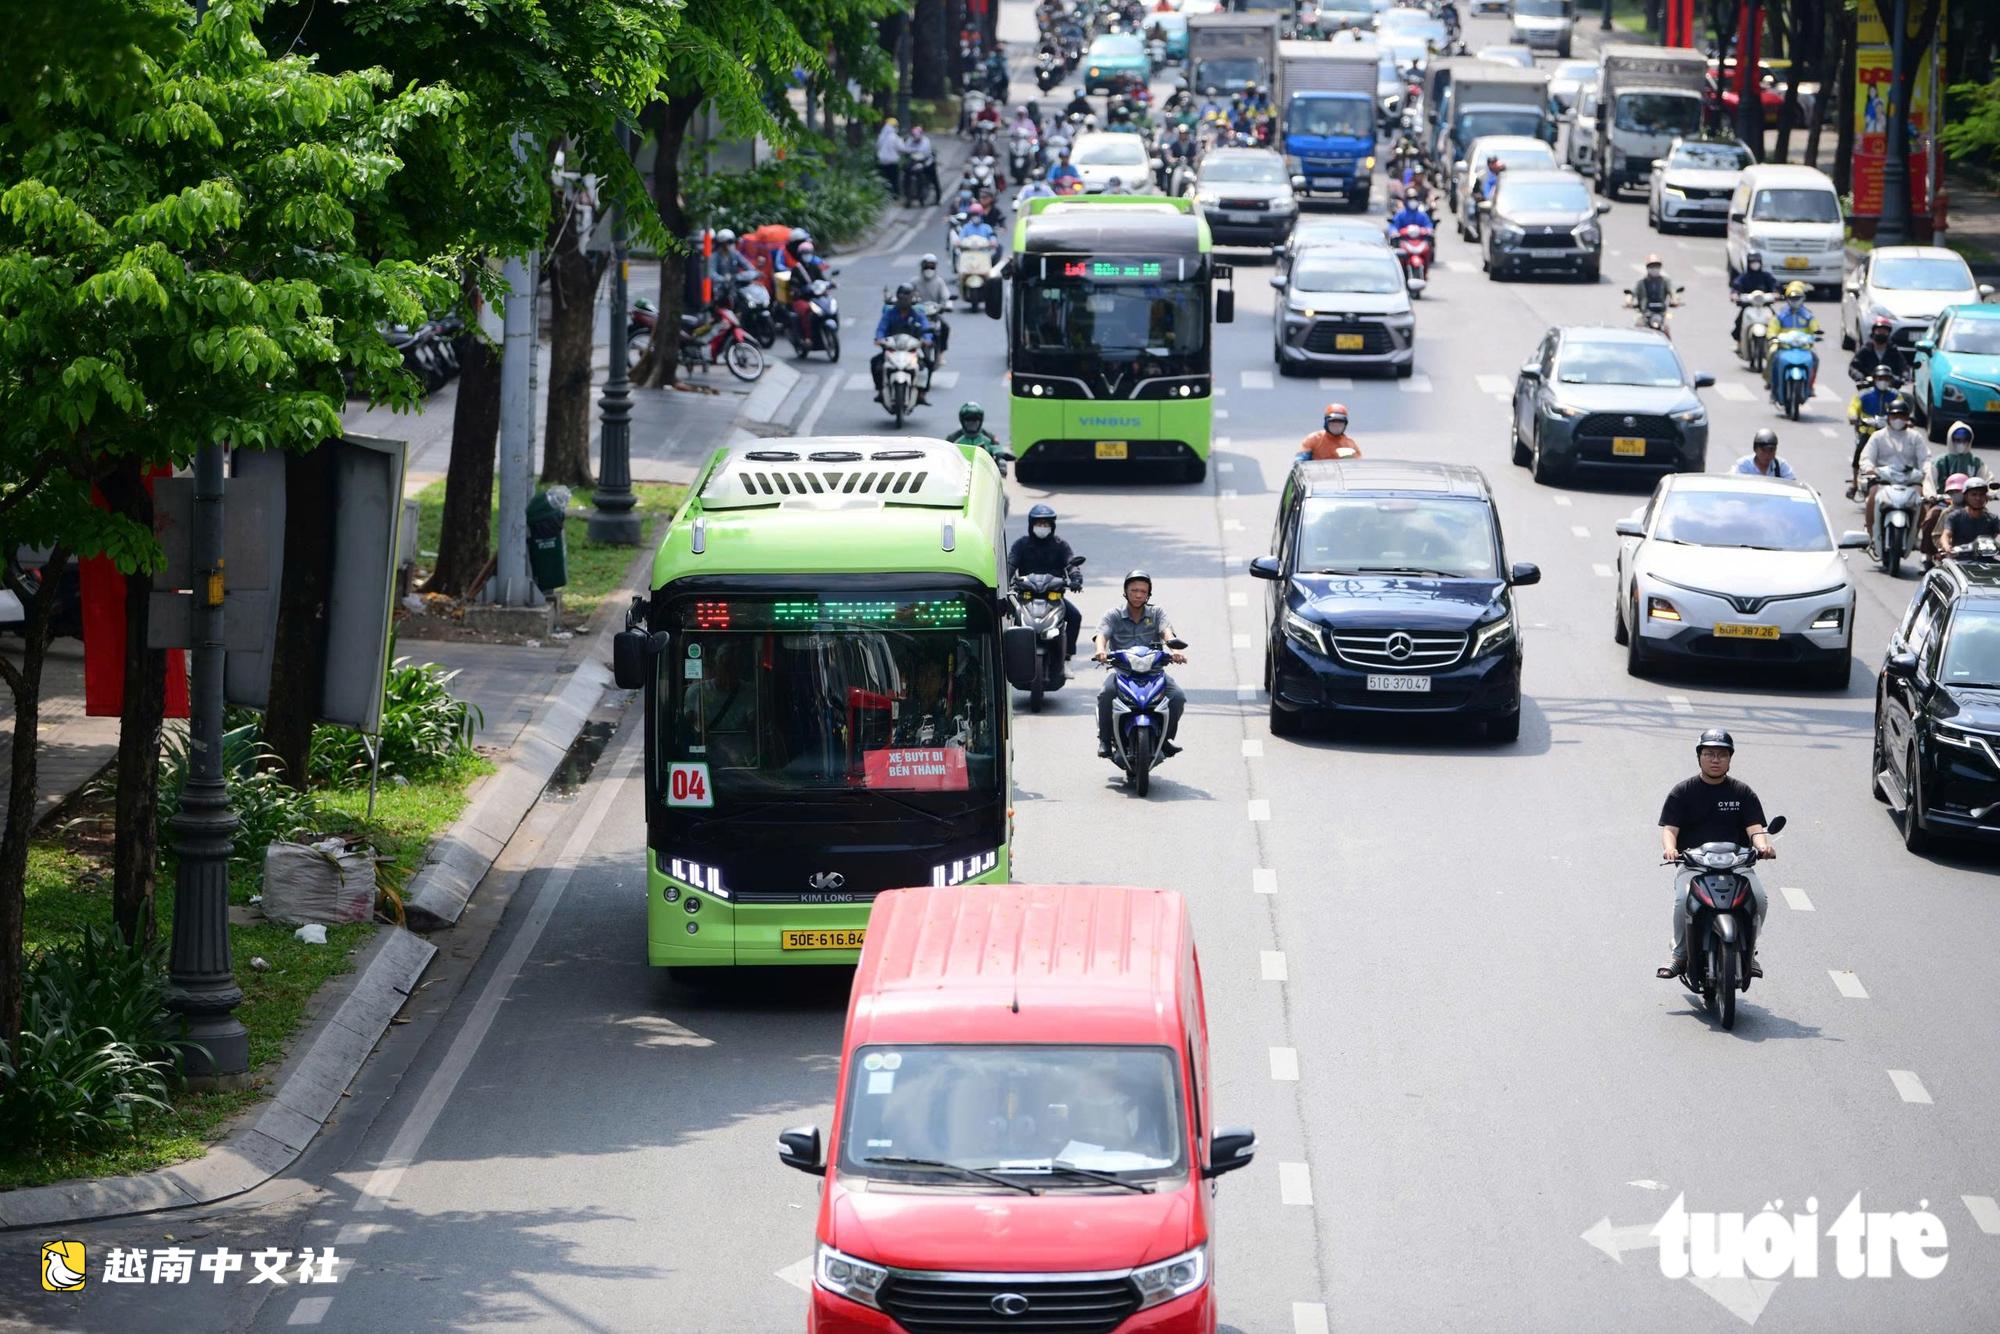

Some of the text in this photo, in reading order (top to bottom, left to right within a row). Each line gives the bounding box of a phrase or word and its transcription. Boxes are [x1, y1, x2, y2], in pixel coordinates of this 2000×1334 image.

[1079, 416, 1142, 427] VINBUS
[889, 752, 902, 763] XE
[672, 769, 705, 800] 04
[800, 893, 854, 903] KIM LONG
[789, 933, 864, 946] 50E-616.84
